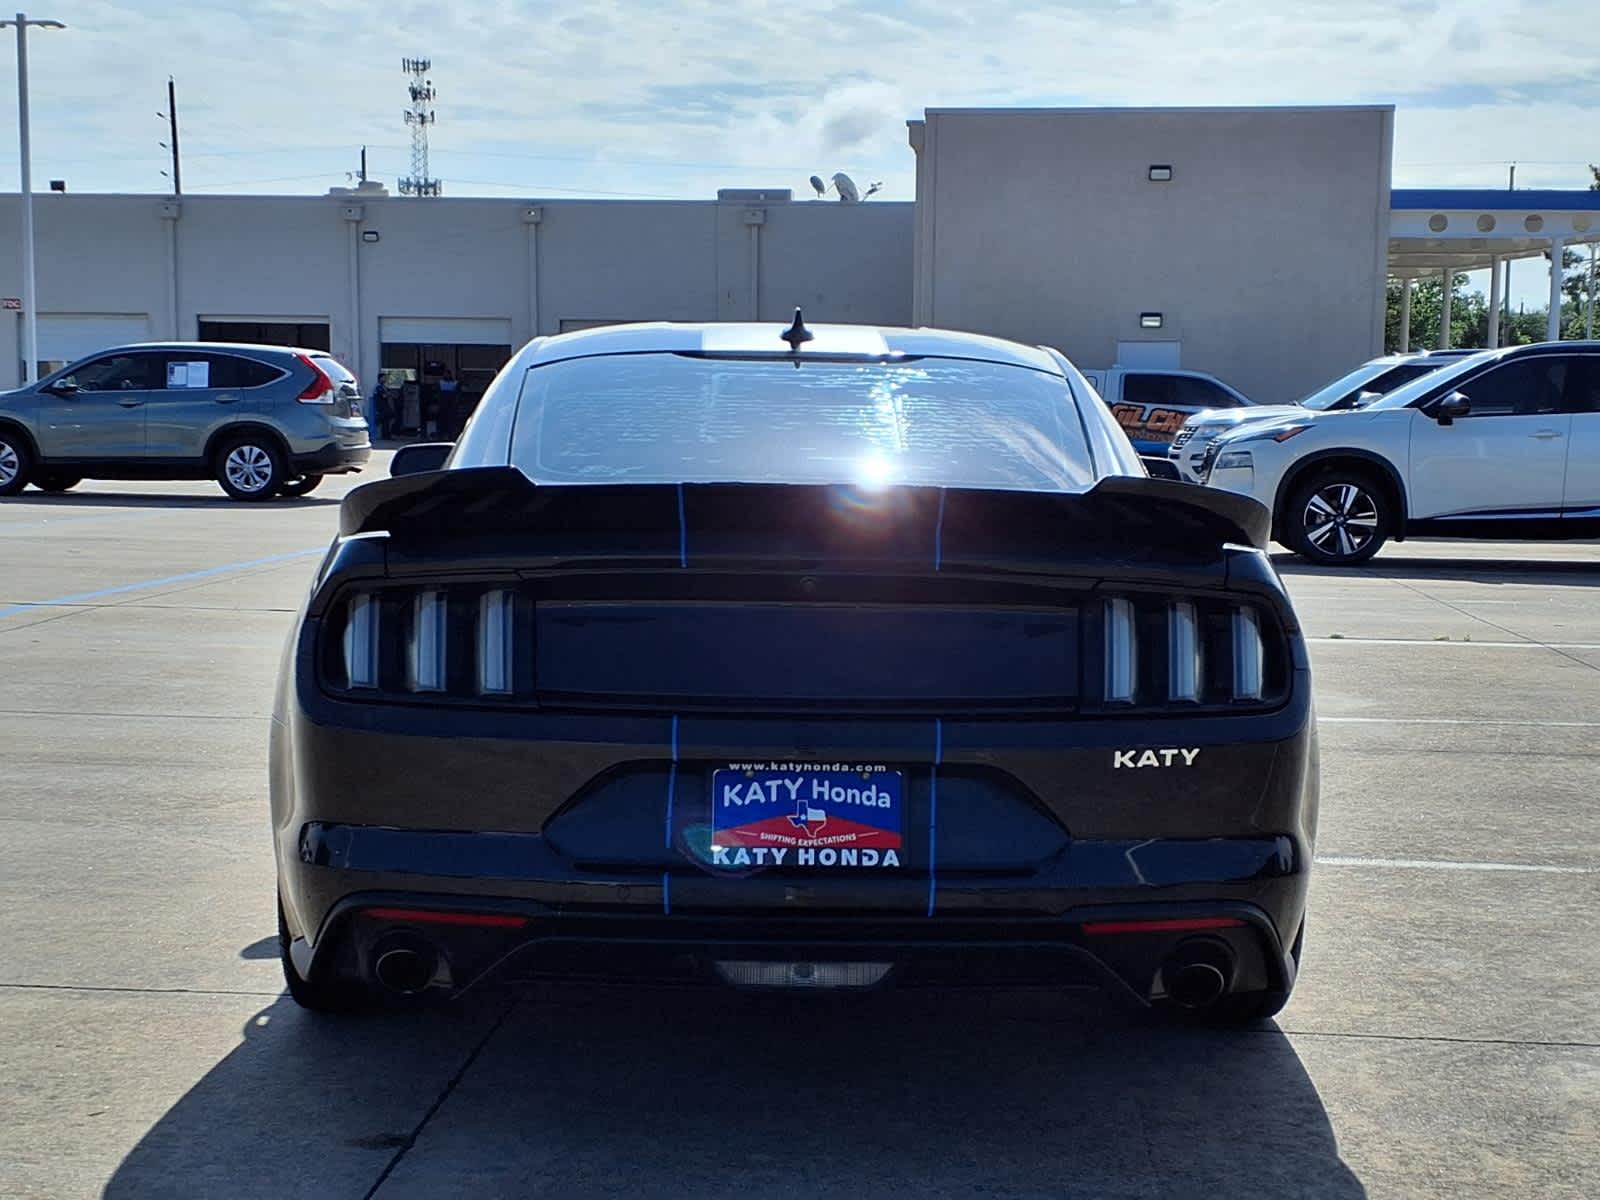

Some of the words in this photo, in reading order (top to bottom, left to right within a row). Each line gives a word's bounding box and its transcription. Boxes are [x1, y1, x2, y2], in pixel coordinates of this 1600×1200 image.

[1113, 748, 1200, 769] KATY
[723, 777, 804, 807] KATY
[812, 778, 891, 808] Honda
[760, 832, 797, 846] SHIFTING
[798, 833, 857, 847] EXPECTATIONS
[712, 848, 787, 865] KATY
[799, 848, 900, 866] HONDA
